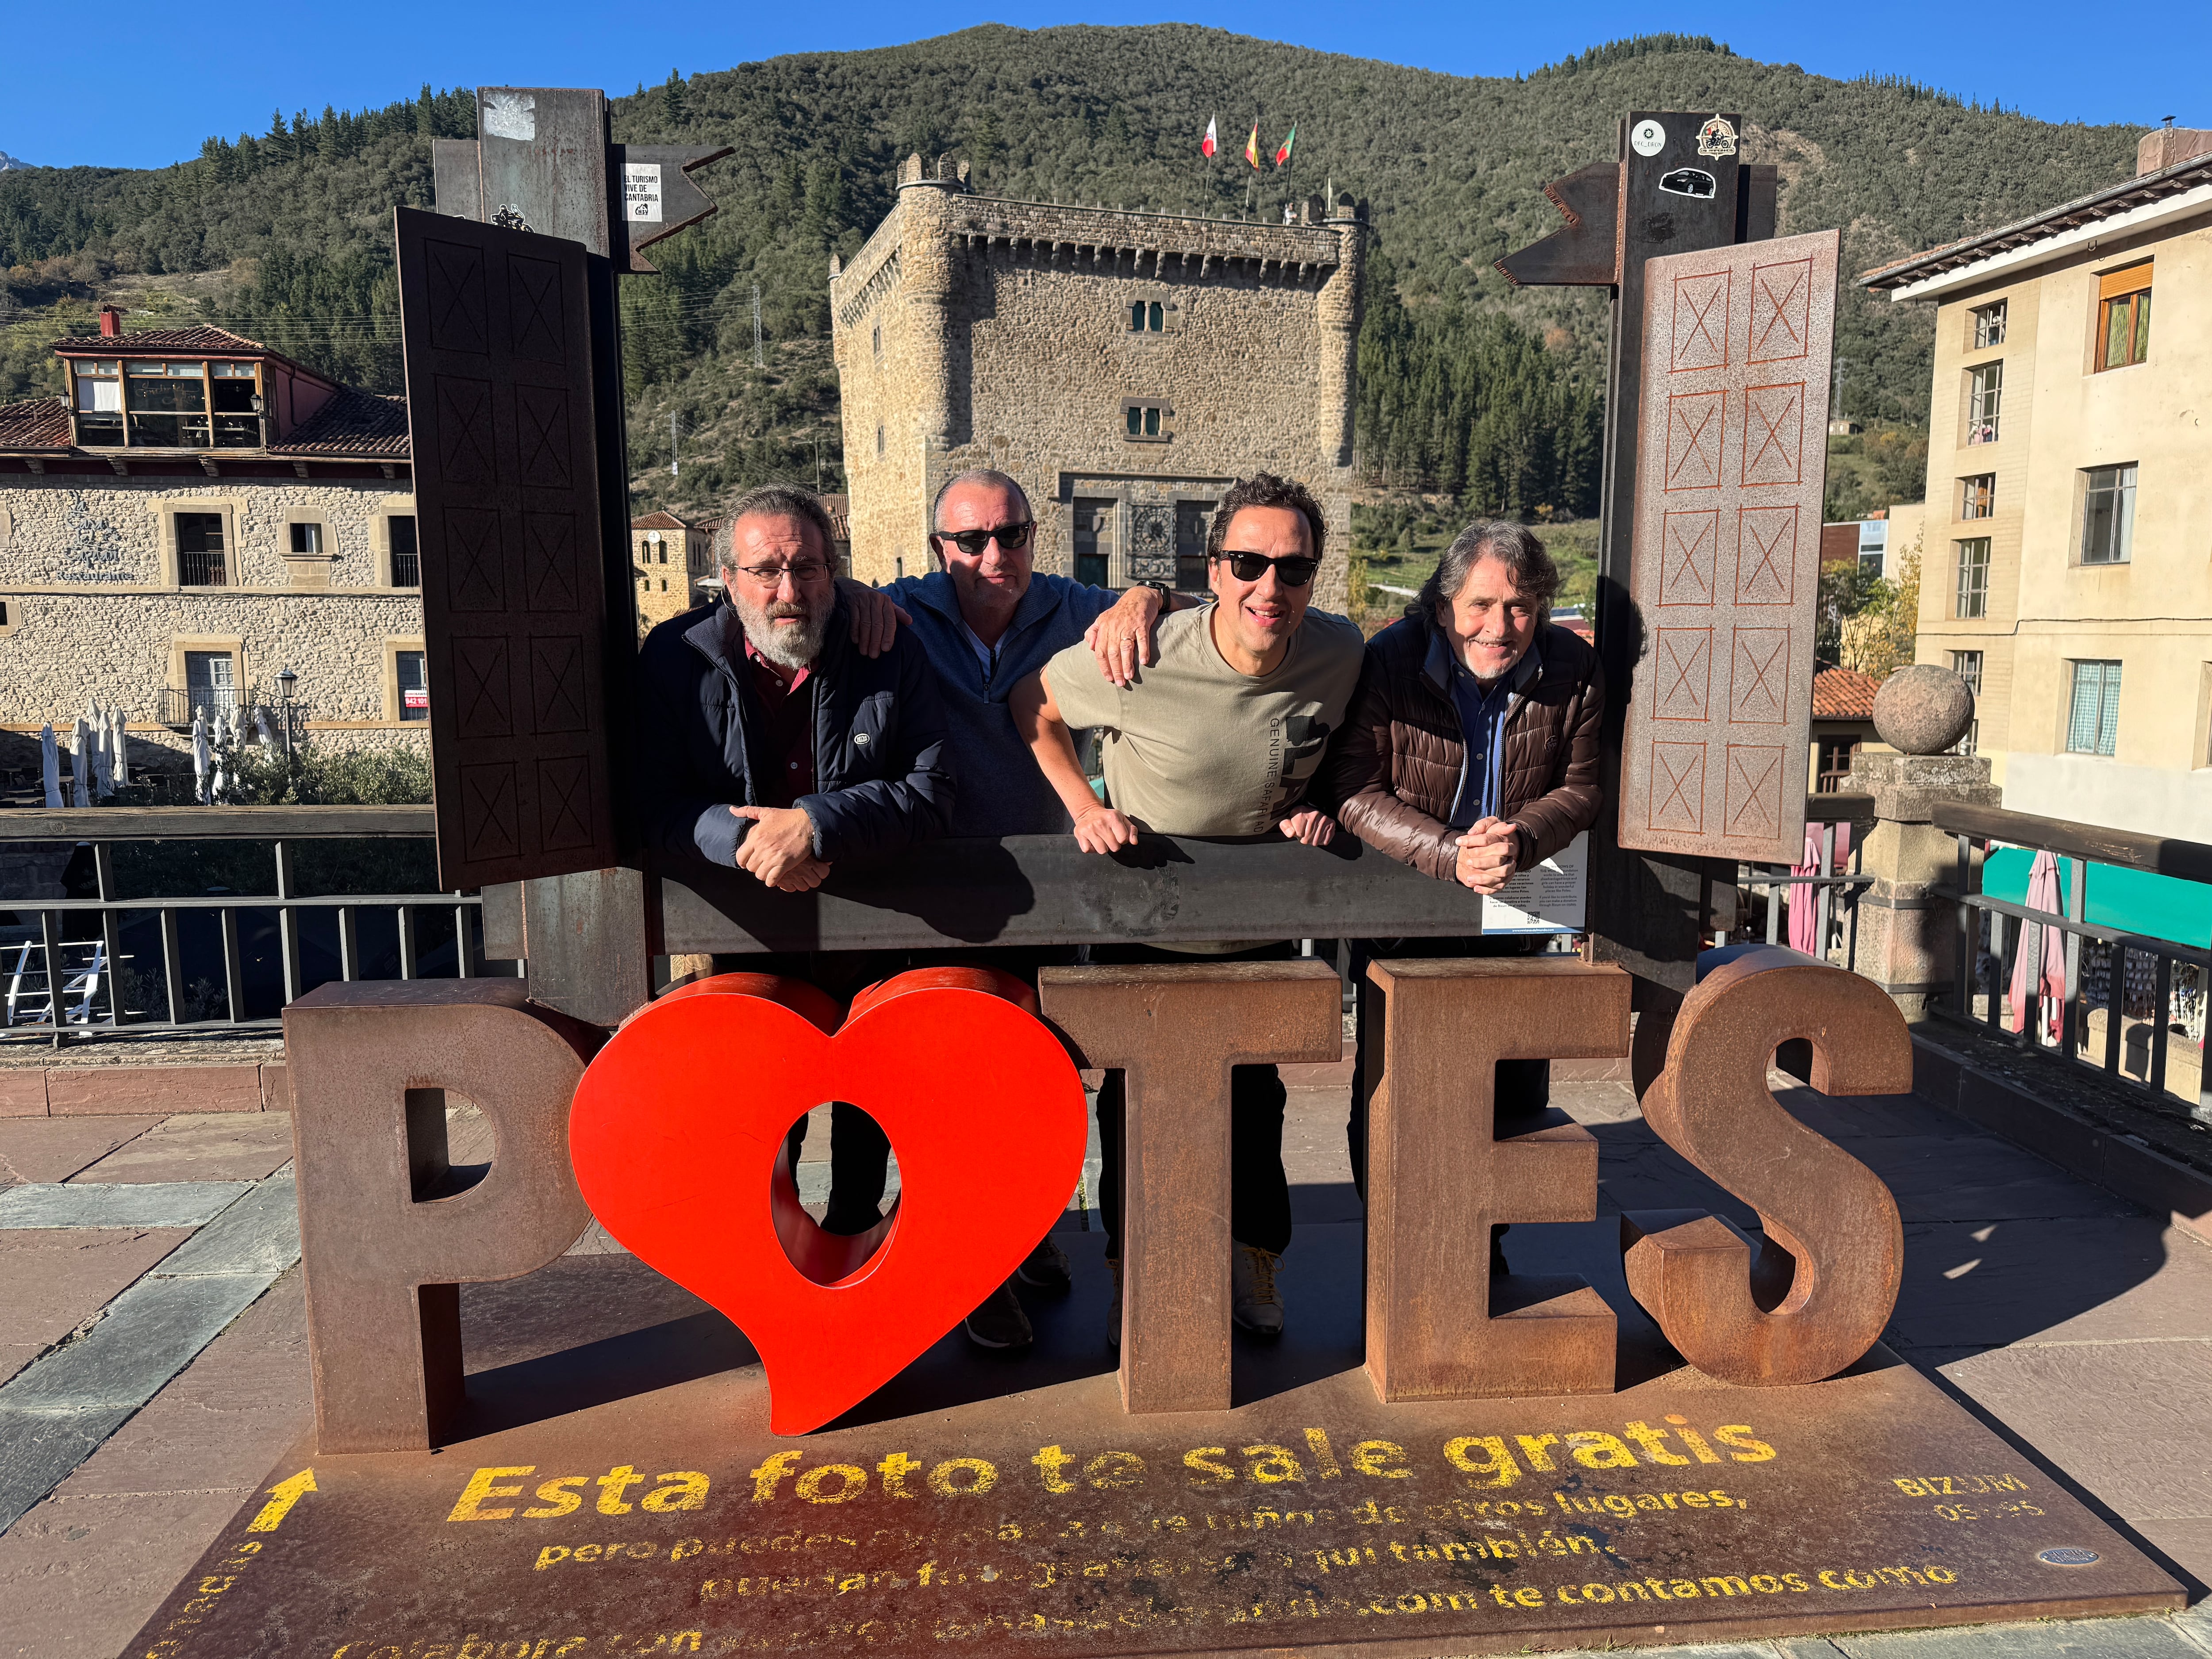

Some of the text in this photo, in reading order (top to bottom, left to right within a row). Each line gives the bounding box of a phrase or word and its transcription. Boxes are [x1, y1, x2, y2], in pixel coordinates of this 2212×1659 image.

[625, 193, 658, 202] CANTABRIA
[56, 570, 133, 580] Restaurante
[1267, 718, 1280, 778] GENUINE
[1257, 782, 1275, 818] SAFARI
[283, 946, 1913, 1455] POTES
[446, 1413, 1776, 1522] Esta foto te sale gratis
[1893, 1473, 2031, 1497] BIZUM
[534, 1541, 658, 1571] pero
[1553, 1489, 1747, 1519] lugares,
[1489, 1584, 1546, 1609] te
[1557, 1573, 1810, 1605] contamos
